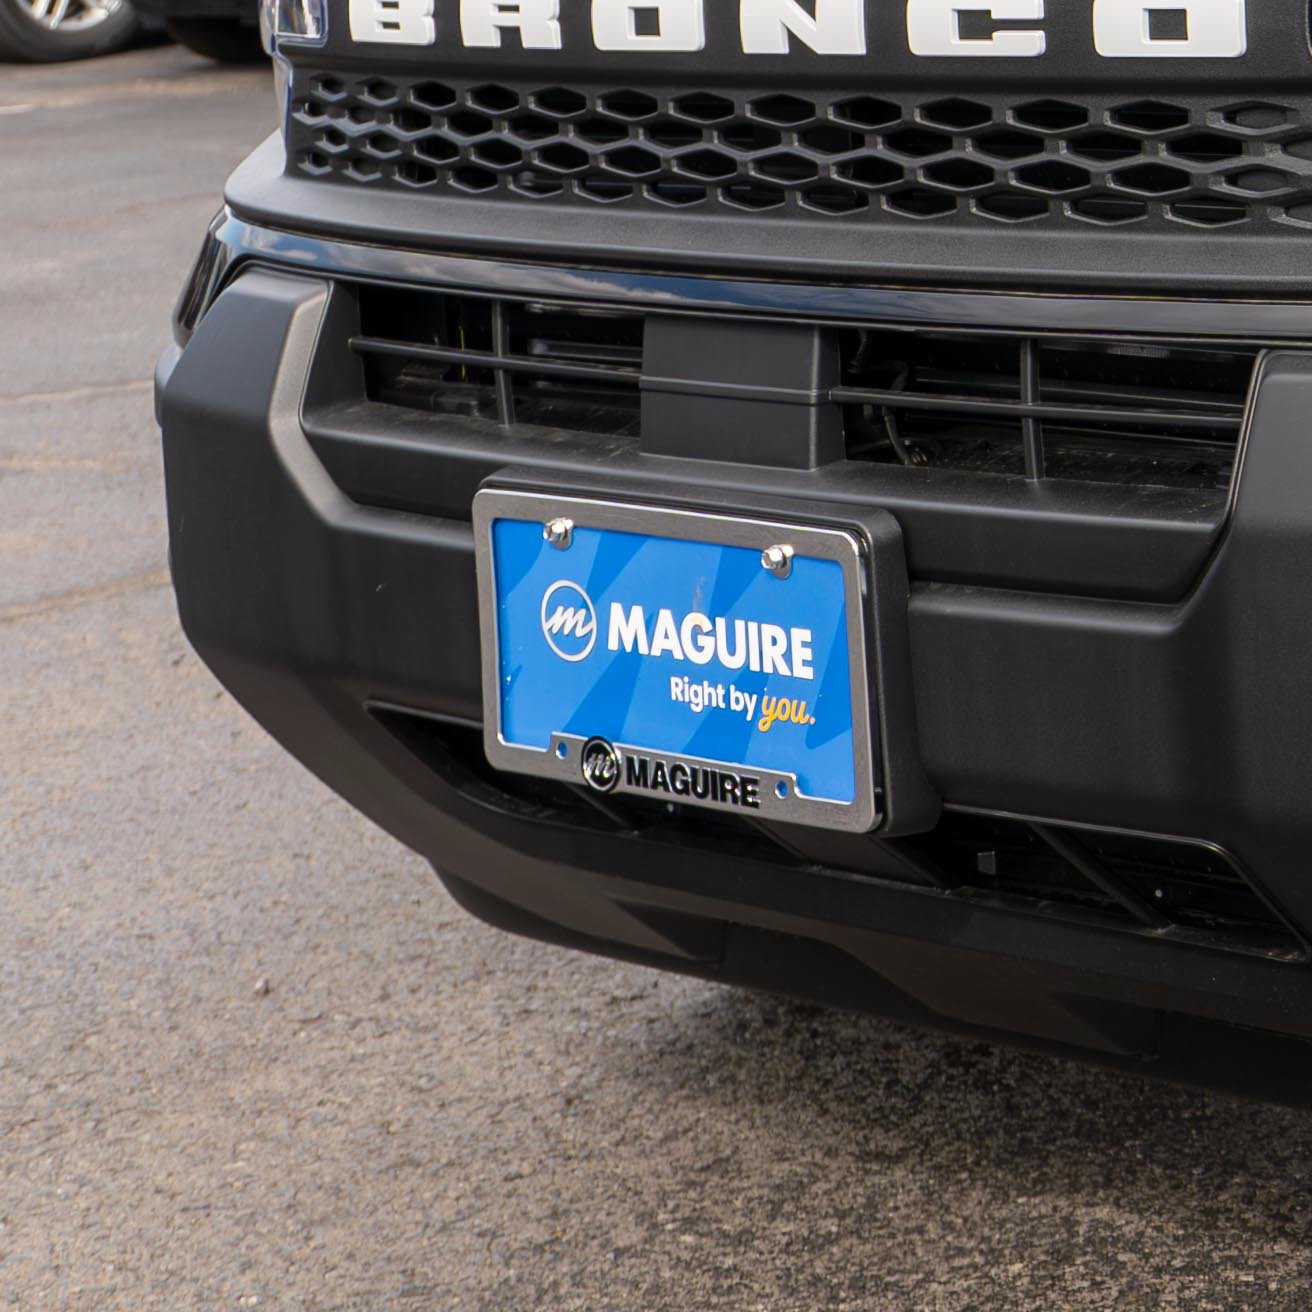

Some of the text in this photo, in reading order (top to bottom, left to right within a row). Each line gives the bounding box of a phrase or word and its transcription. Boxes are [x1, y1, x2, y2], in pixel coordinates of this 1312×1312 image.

[607, 602, 814, 680] MAGUIRE
[670, 676, 817, 733] Right by you.
[626, 755, 761, 809] MAGUIRE
